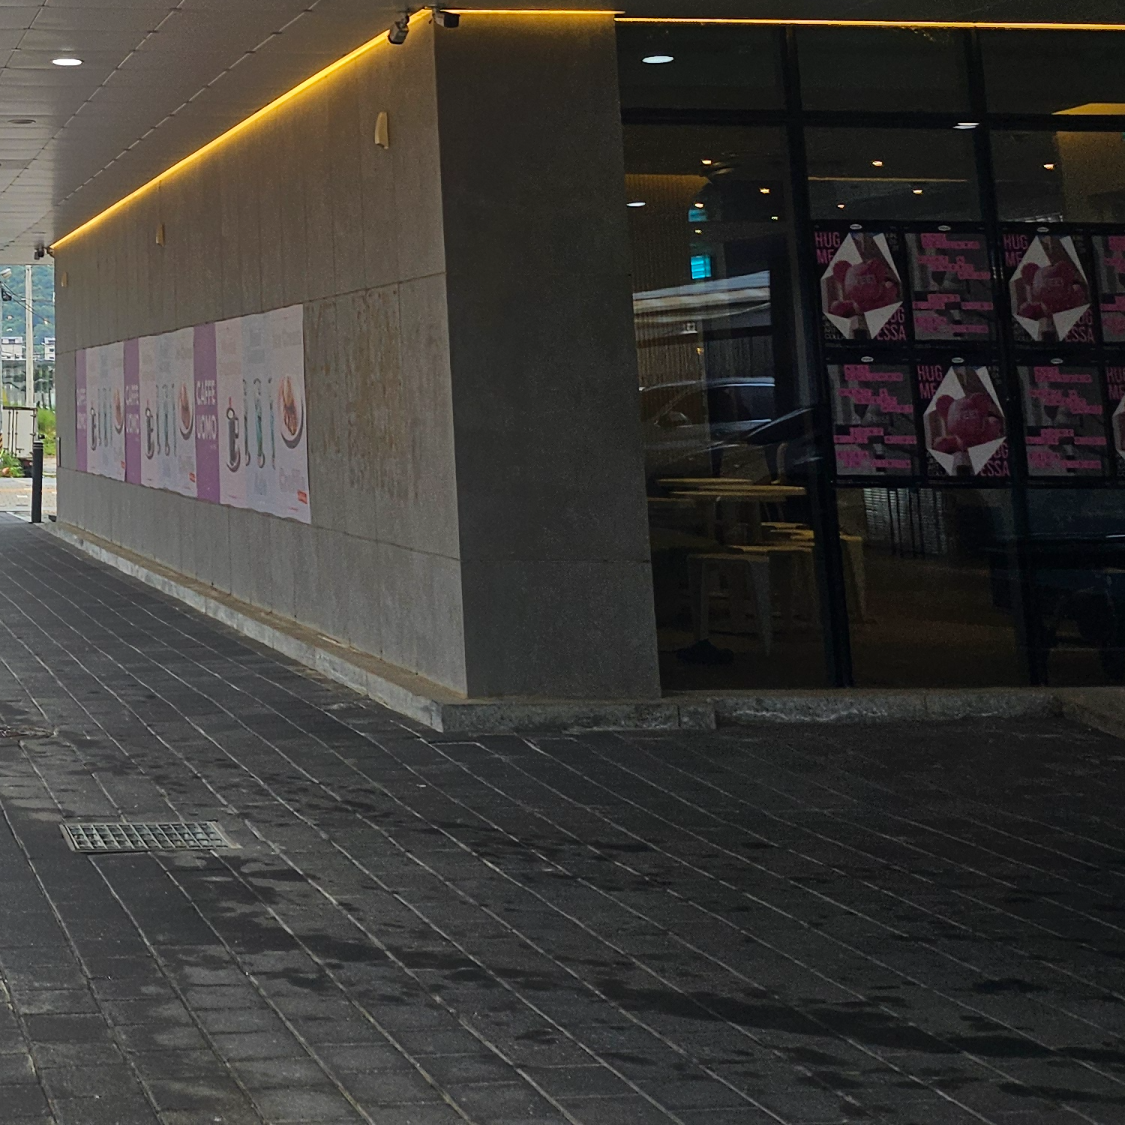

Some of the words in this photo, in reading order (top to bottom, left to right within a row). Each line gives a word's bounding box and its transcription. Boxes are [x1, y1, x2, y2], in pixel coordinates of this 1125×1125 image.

[814, 231, 841, 248] HUG
[1003, 234, 1029, 250] HUG
[916, 364, 944, 381] HUG
[196, 379, 215, 406] CAFFE
[196, 414, 217, 440] UOMO
